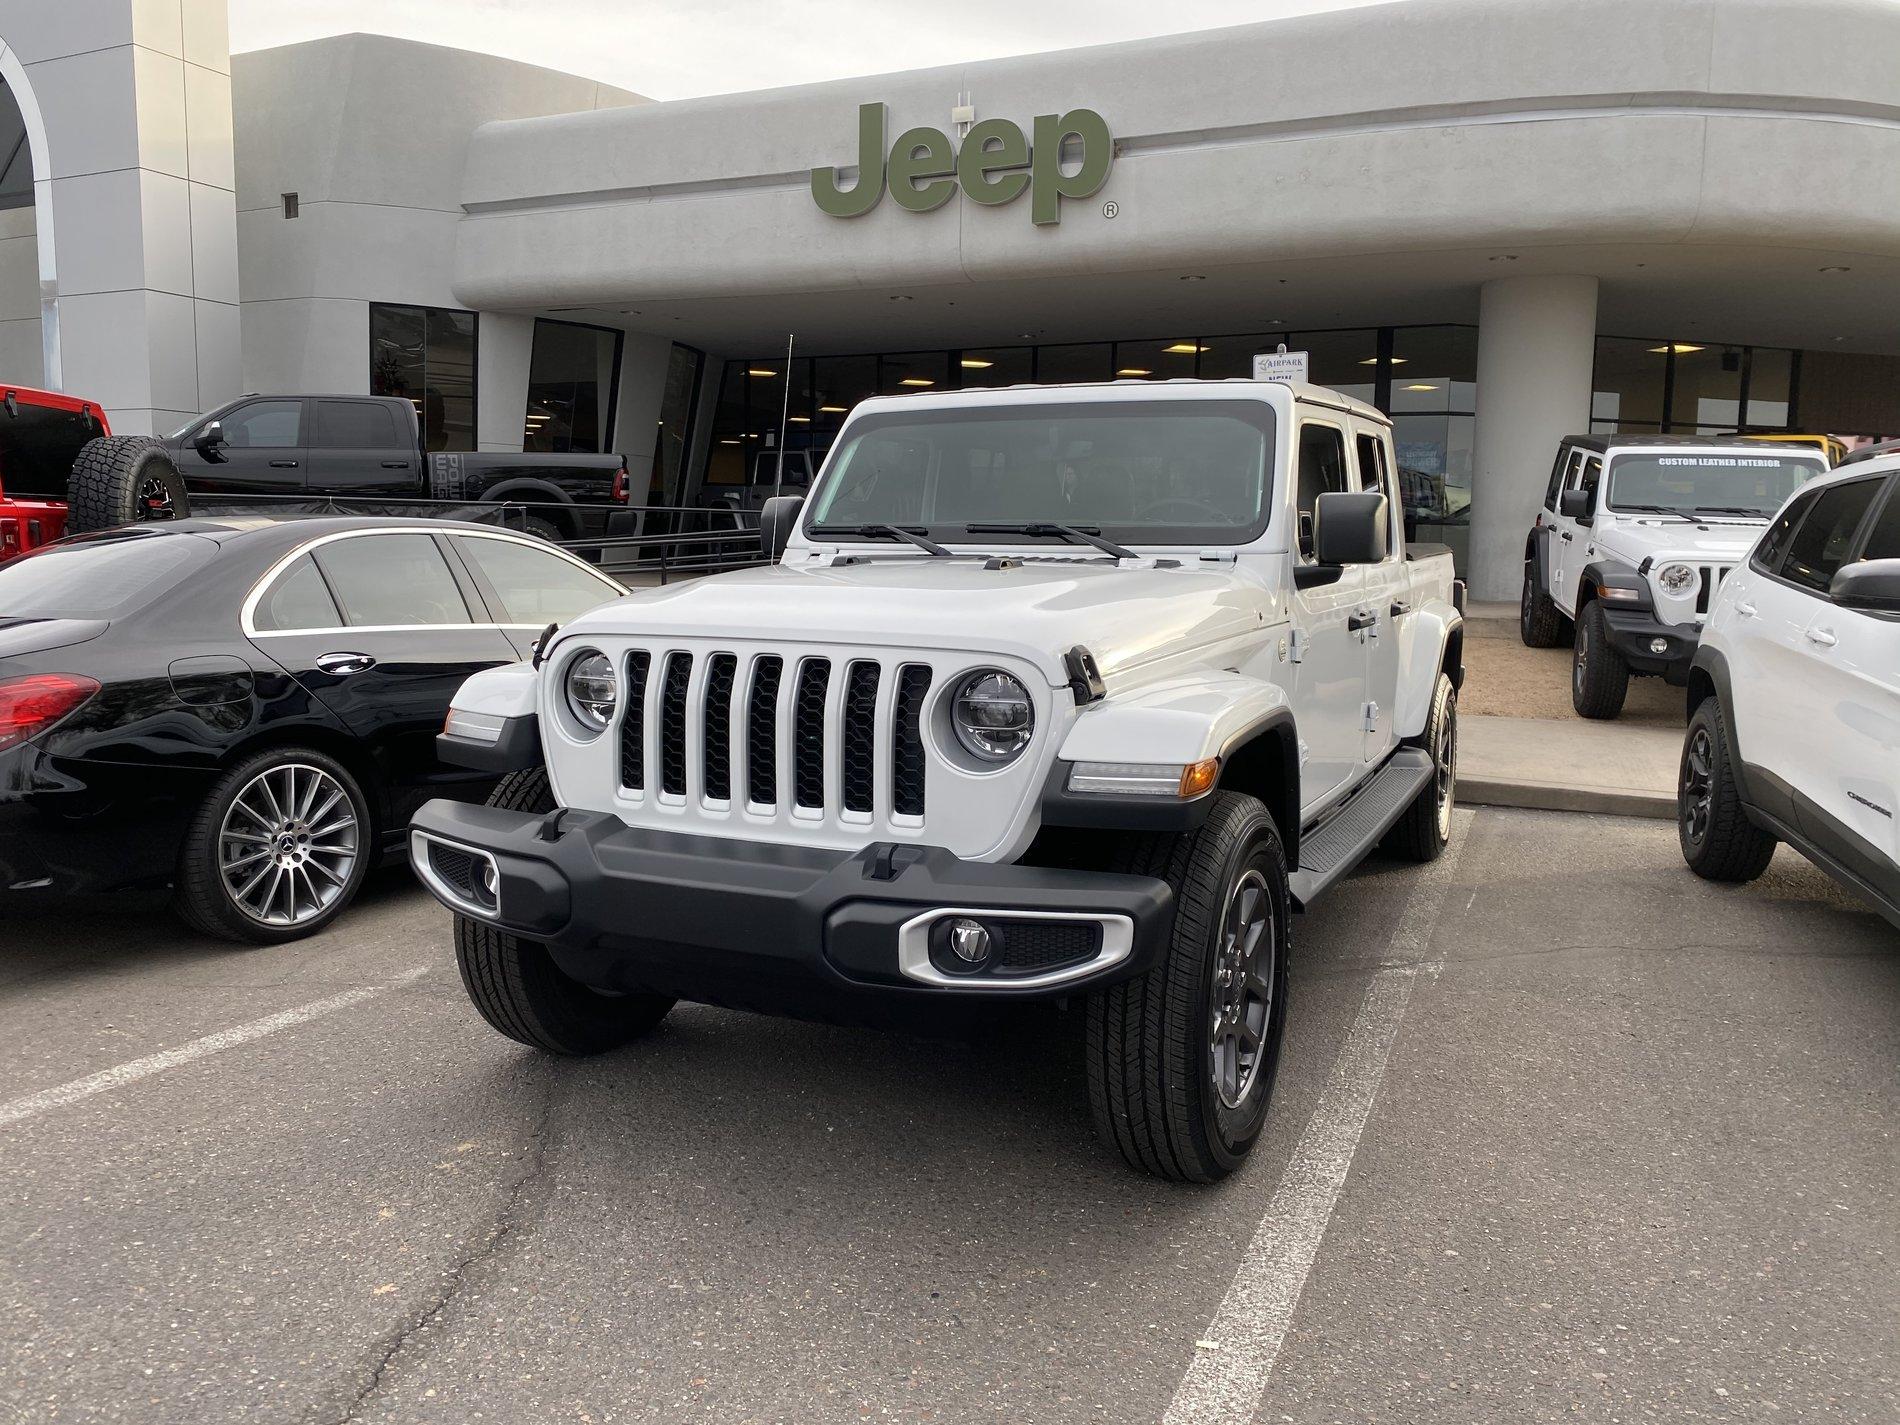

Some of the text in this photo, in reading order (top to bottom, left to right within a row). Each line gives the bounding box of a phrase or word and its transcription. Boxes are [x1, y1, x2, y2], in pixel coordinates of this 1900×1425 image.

[811, 102, 1114, 225] Jeep
[1267, 358, 1303, 368] AIRPARK
[436, 454, 447, 500] WAG
[447, 454, 460, 500] POW
[1659, 458, 1781, 468] CUSTOM LEATHER INTERIOR
